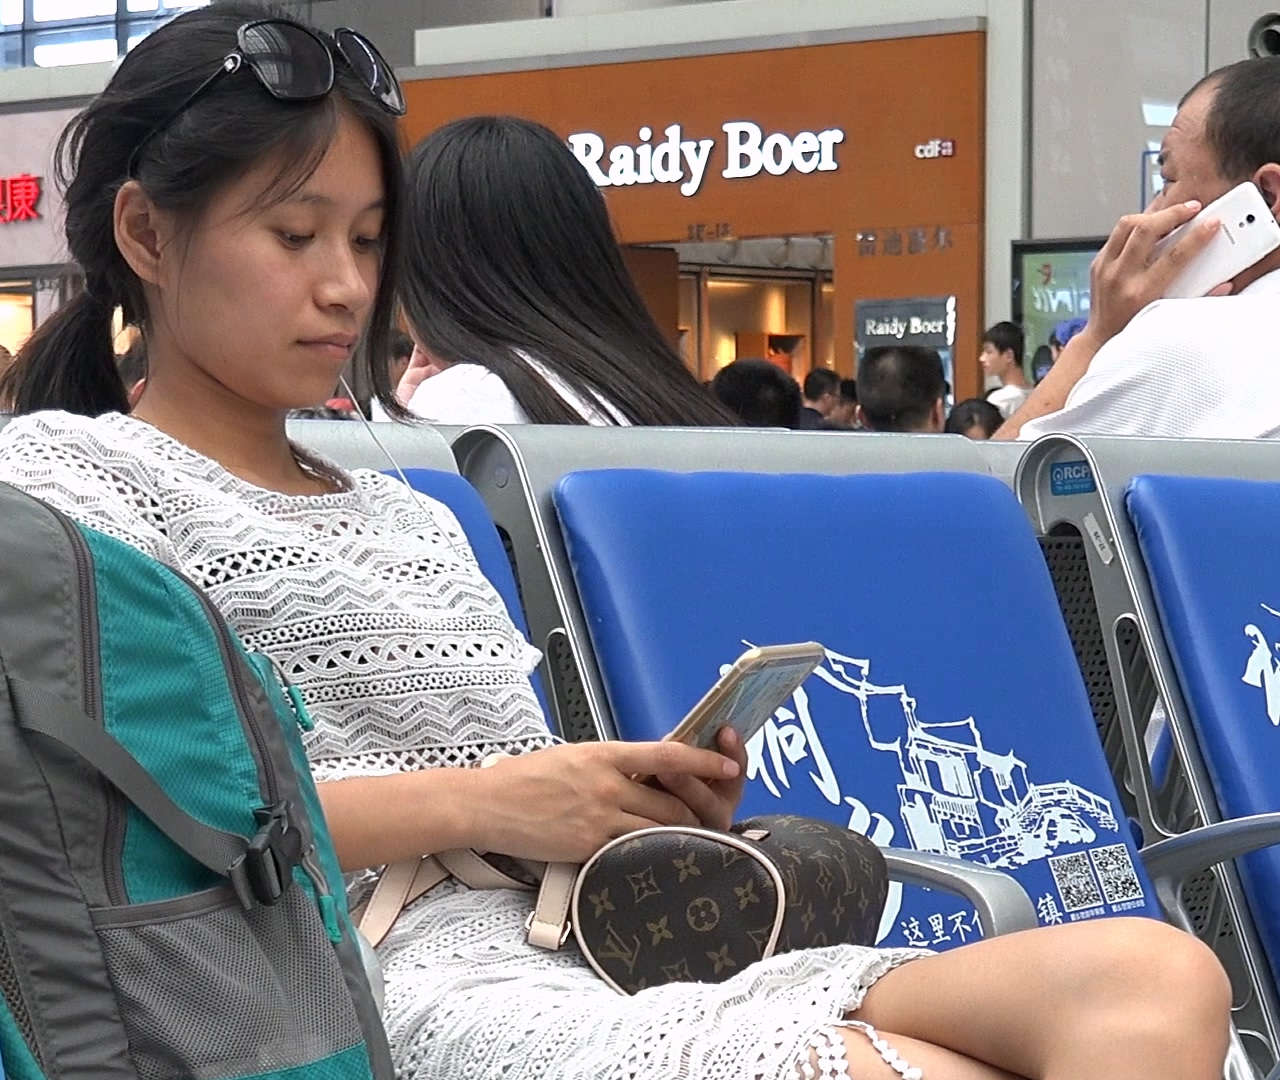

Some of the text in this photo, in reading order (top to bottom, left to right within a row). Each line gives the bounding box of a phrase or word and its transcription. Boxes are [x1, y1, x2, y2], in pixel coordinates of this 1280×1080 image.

[568, 121, 844, 196] Raidy Boer
[865, 317, 906, 338] Raidy
[910, 315, 945, 335] Boer
